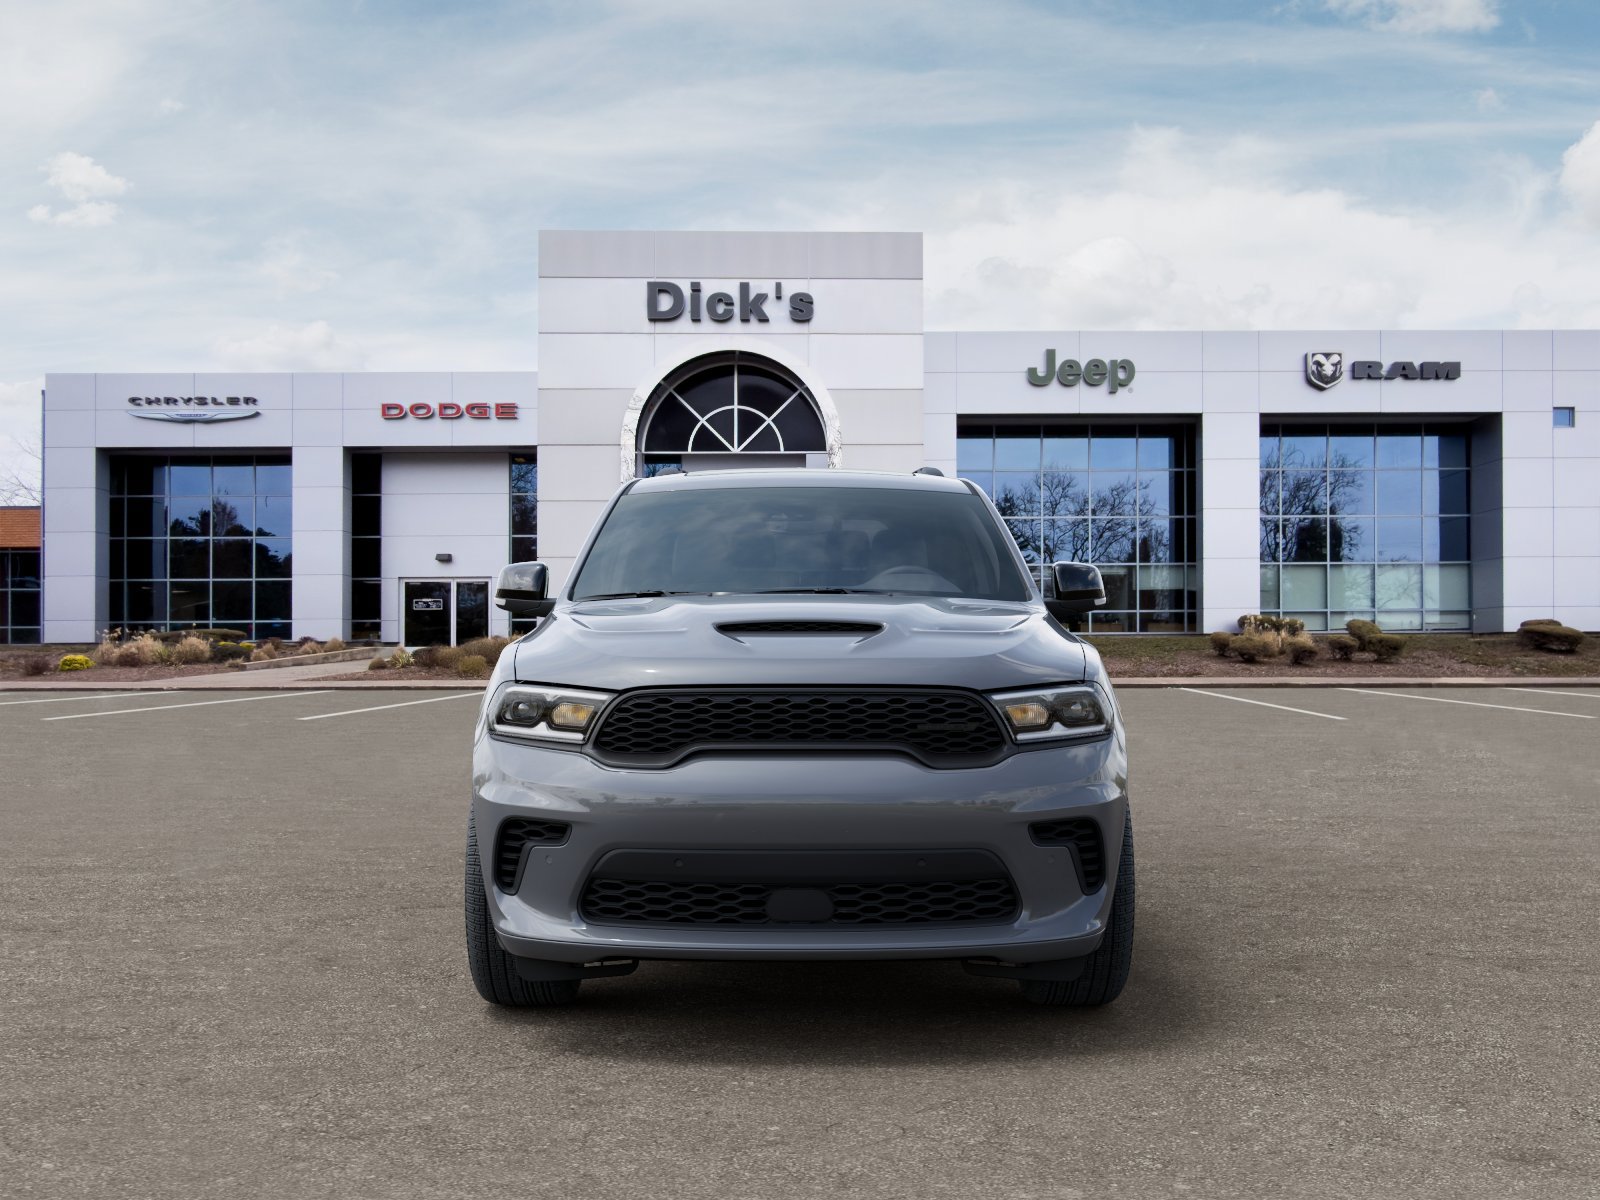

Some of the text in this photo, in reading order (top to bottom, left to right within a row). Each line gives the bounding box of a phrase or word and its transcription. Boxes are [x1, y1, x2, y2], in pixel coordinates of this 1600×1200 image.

[646, 281, 814, 322] Dick's
[1027, 348, 1136, 394] Jeep
[1351, 360, 1461, 380] RAM
[127, 396, 259, 407] CHRYSLER
[381, 402, 519, 420] DODGE
